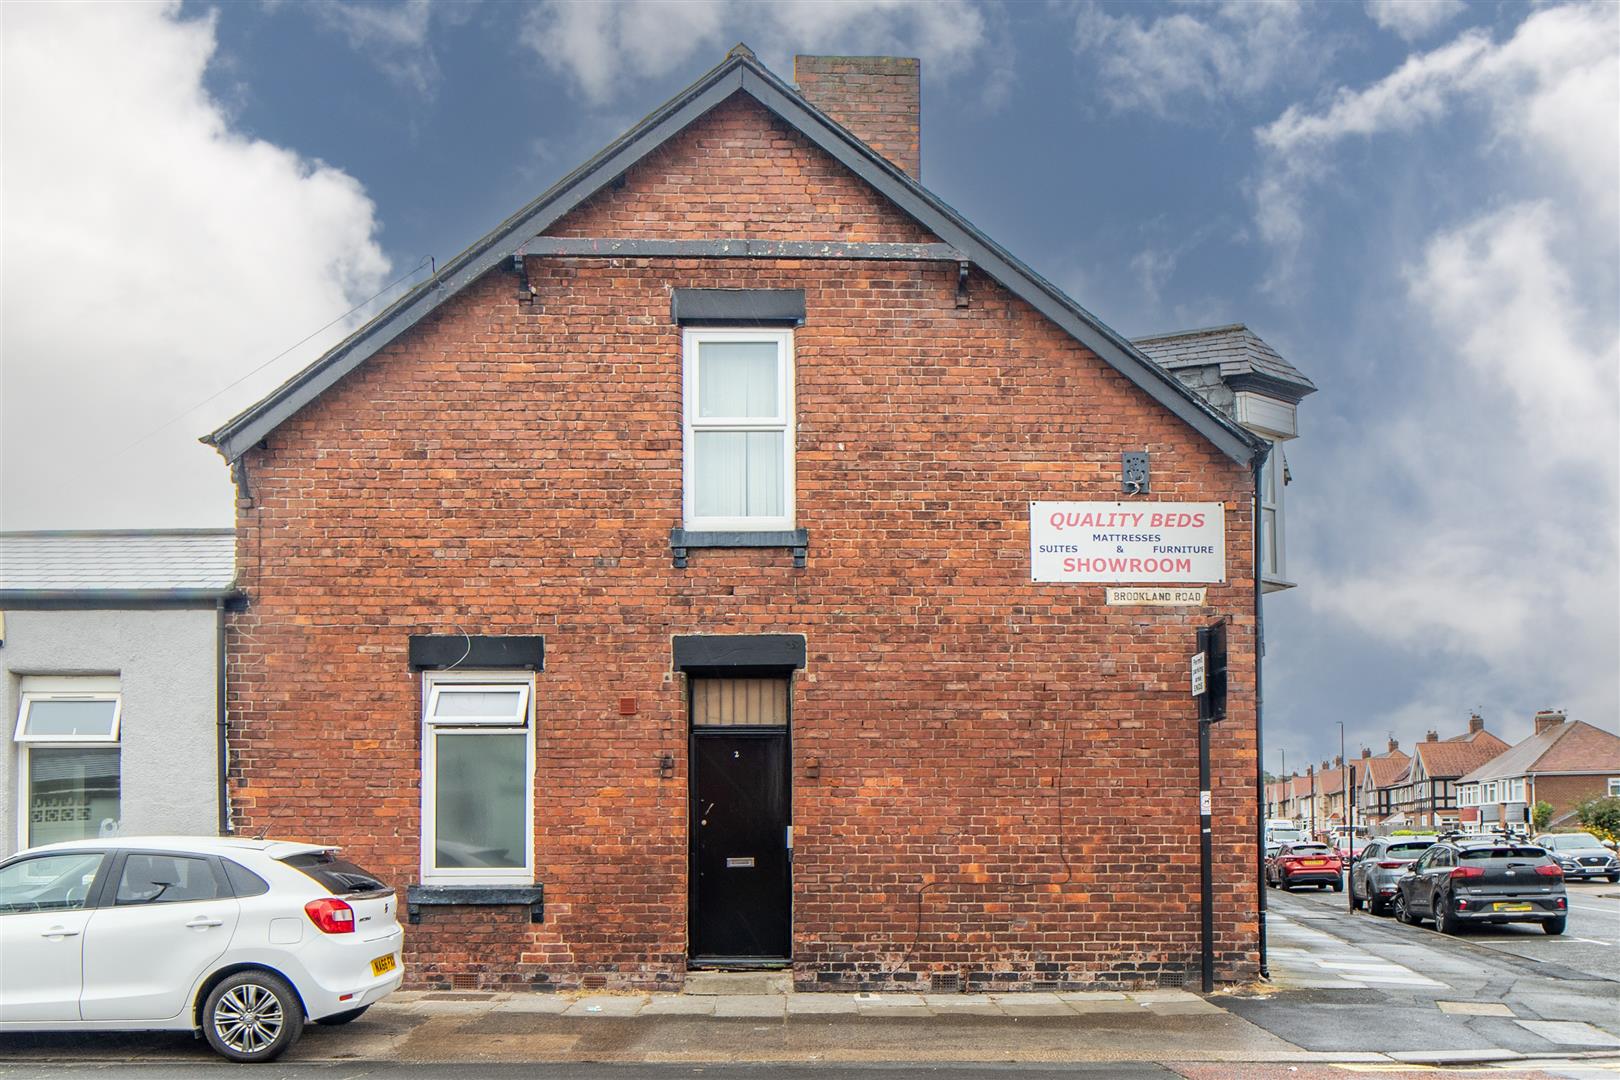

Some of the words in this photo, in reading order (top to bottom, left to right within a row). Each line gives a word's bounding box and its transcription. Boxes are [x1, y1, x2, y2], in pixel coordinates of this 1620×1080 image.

[1050, 512, 1144, 530] QUALITY
[1151, 513, 1205, 528] BEDS
[1092, 534, 1161, 542] MATTRESSES
[1039, 545, 1078, 553] SUITES
[1116, 545, 1124, 553] &
[1153, 545, 1214, 554] FURNITURE
[1063, 558, 1191, 573] SHOWROOM
[1114, 592, 1171, 601] BROOKLAND
[1175, 592, 1201, 601] ROAD
[734, 750, 740, 758] 2
